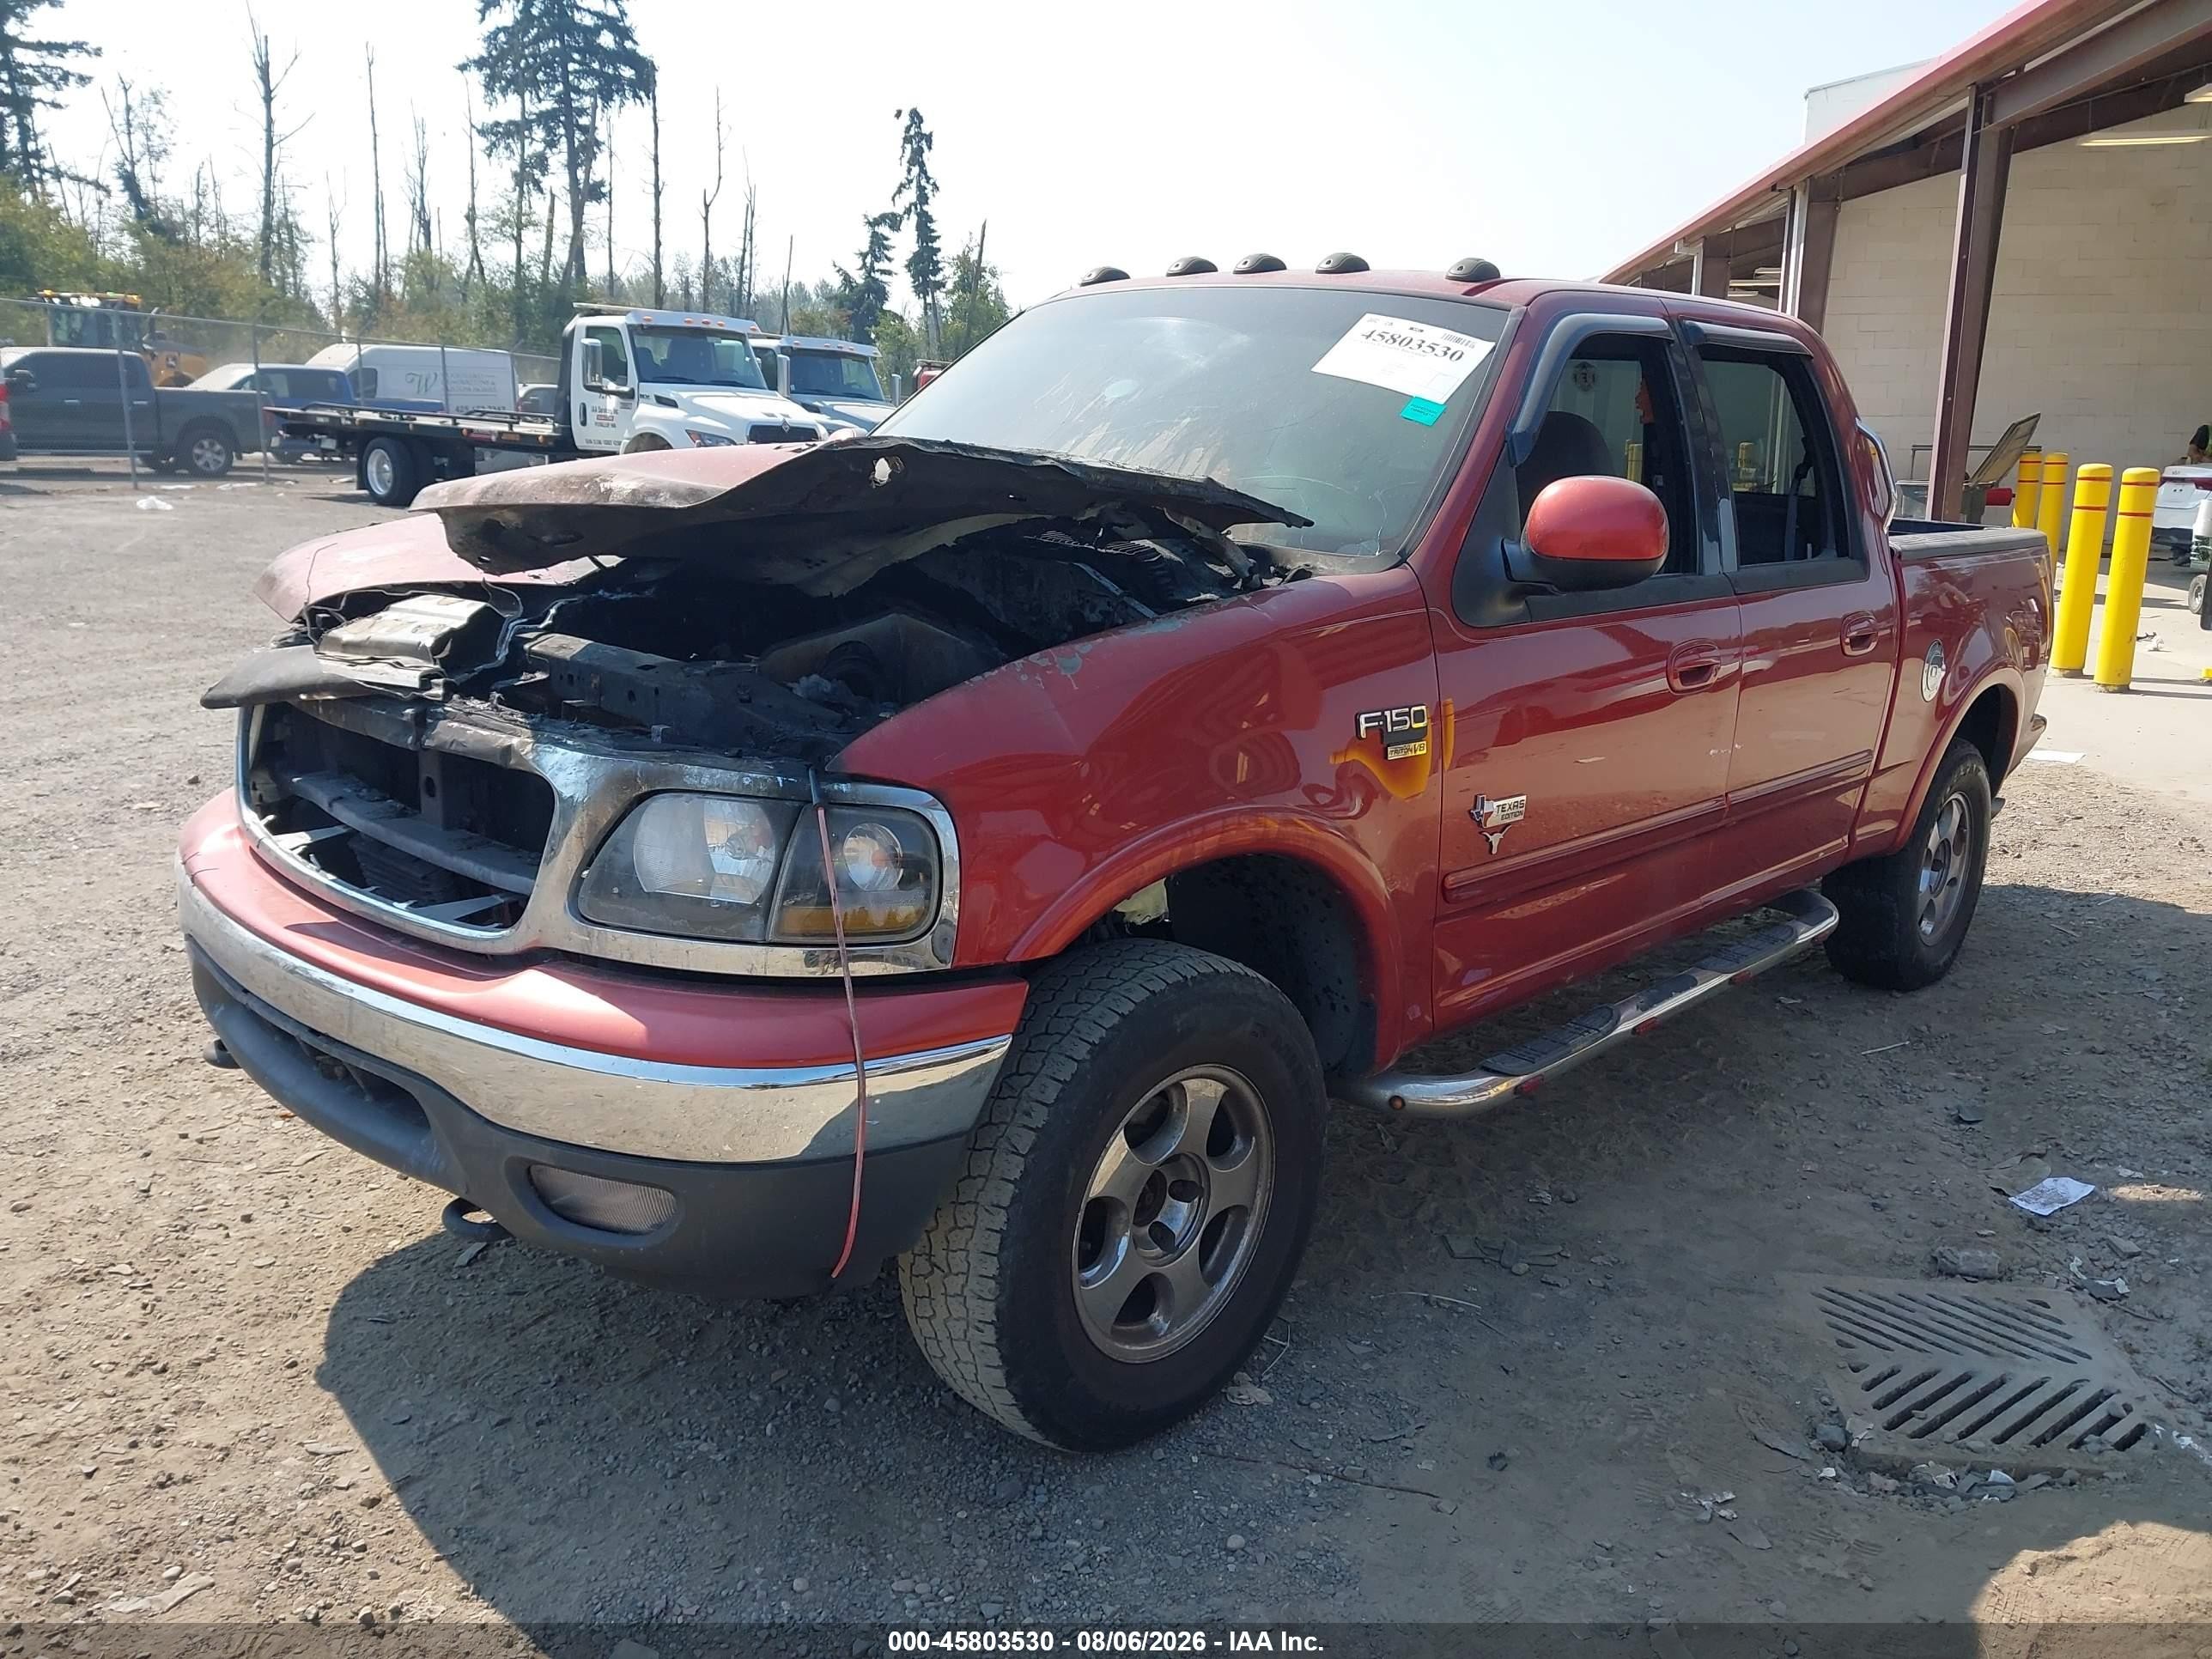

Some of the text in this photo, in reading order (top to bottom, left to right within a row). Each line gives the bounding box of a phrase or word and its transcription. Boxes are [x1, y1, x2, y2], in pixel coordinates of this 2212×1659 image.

[1360, 328, 1465, 362] 45803530
[1358, 704, 1428, 738] F-150
[1389, 743, 1425, 757] TRITON V8
[1496, 799, 1526, 814] TEXAS
[1500, 810, 1524, 821] EDITION
